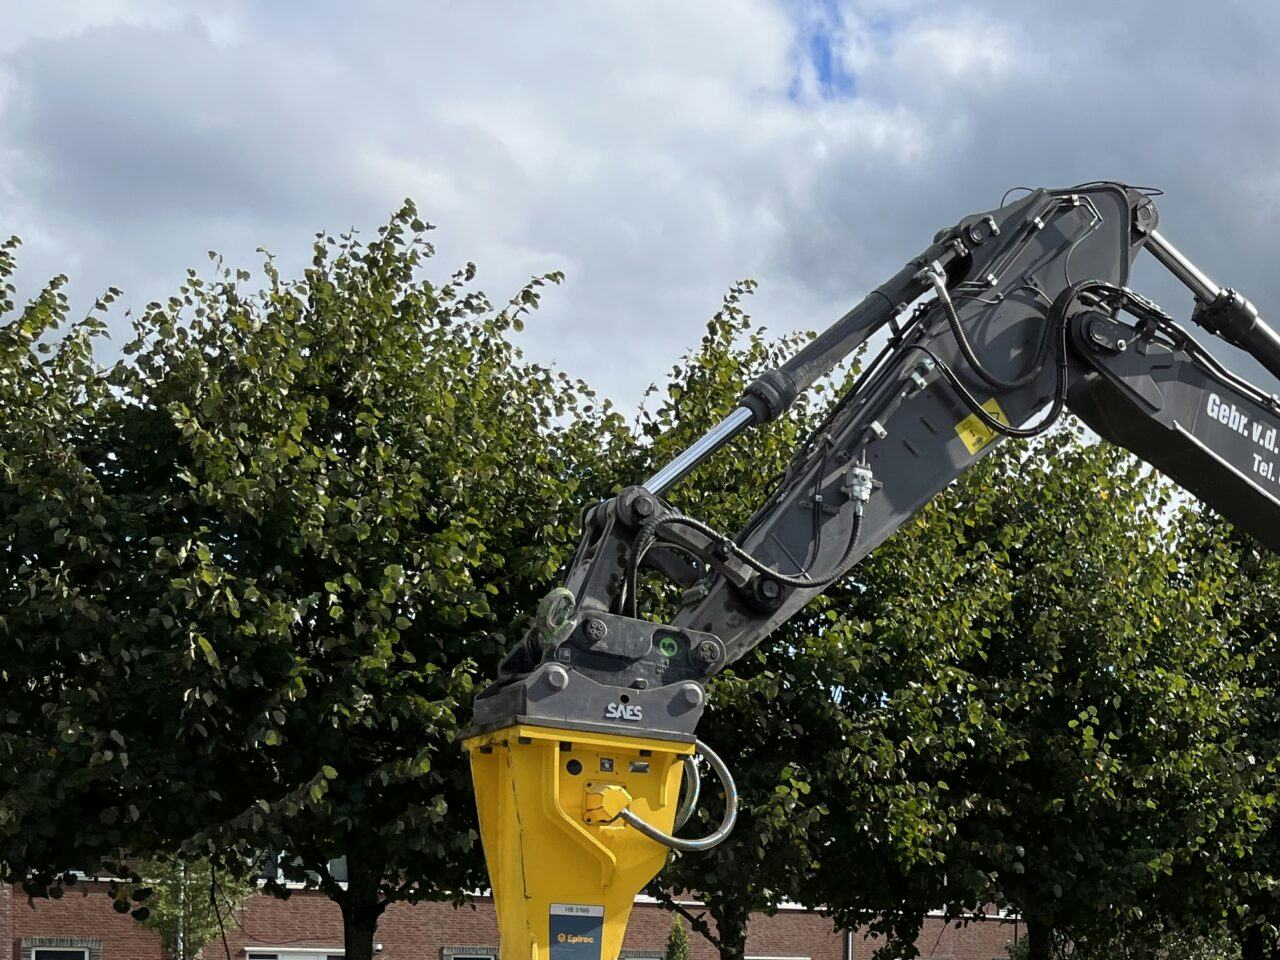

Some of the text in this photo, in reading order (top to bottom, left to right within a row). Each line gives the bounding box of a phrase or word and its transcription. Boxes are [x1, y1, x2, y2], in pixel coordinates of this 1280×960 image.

[1206, 392, 1249, 437] Gebr.
[1252, 421, 1279, 455] v.d.
[1252, 453, 1275, 482] Tel.
[605, 702, 643, 721] SAES
[567, 934, 595, 944] Epiroc
